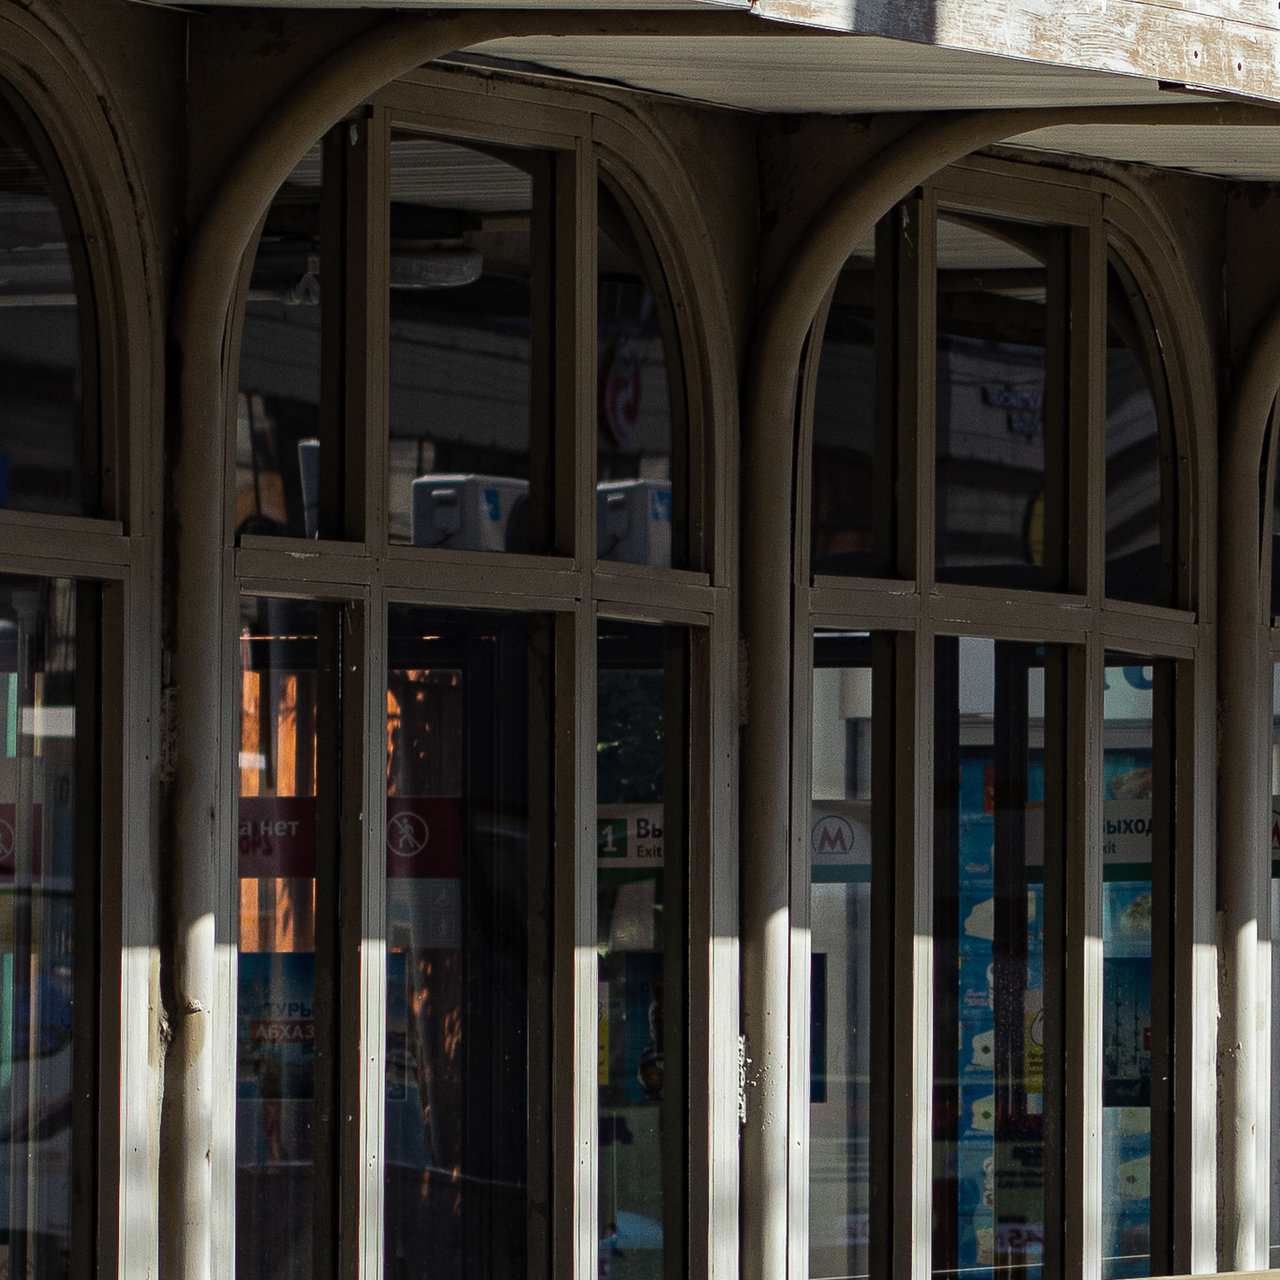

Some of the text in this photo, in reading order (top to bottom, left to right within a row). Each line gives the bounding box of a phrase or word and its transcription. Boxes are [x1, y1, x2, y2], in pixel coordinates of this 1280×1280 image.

[261, 820, 299, 836] нет
[602, 825, 617, 852] 1
[636, 846, 663, 858] Exit
